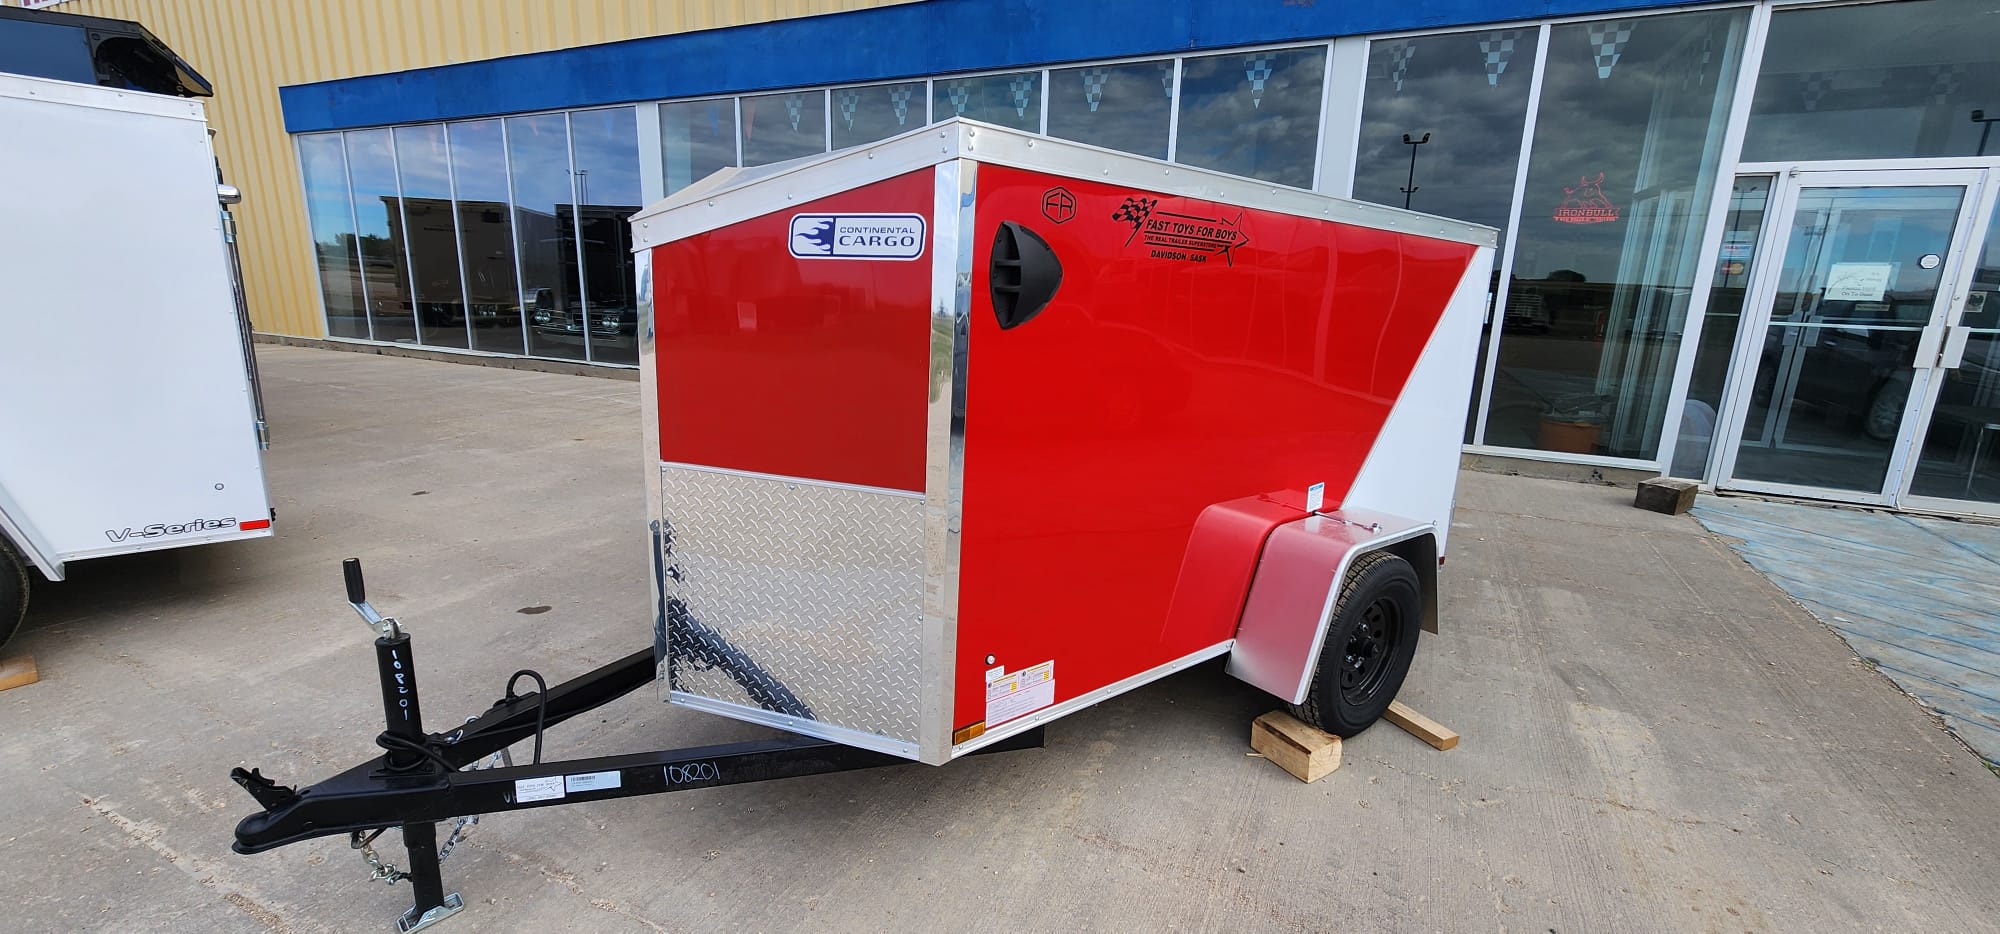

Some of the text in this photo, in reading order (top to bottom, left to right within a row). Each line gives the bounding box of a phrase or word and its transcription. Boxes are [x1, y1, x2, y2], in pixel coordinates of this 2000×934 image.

[839, 226, 915, 234] CONTINENTAL
[1146, 219, 1238, 241] FAST TOYS FOR BOYS
[838, 235, 915, 247] CARGO
[1155, 235, 1167, 243] REAL
[1168, 237, 1188, 245] TRAILER
[1150, 249, 1207, 263] DAVIDSON SASK
[105, 517, 236, 542] V-Series
[663, 761, 720, 786] 108201
